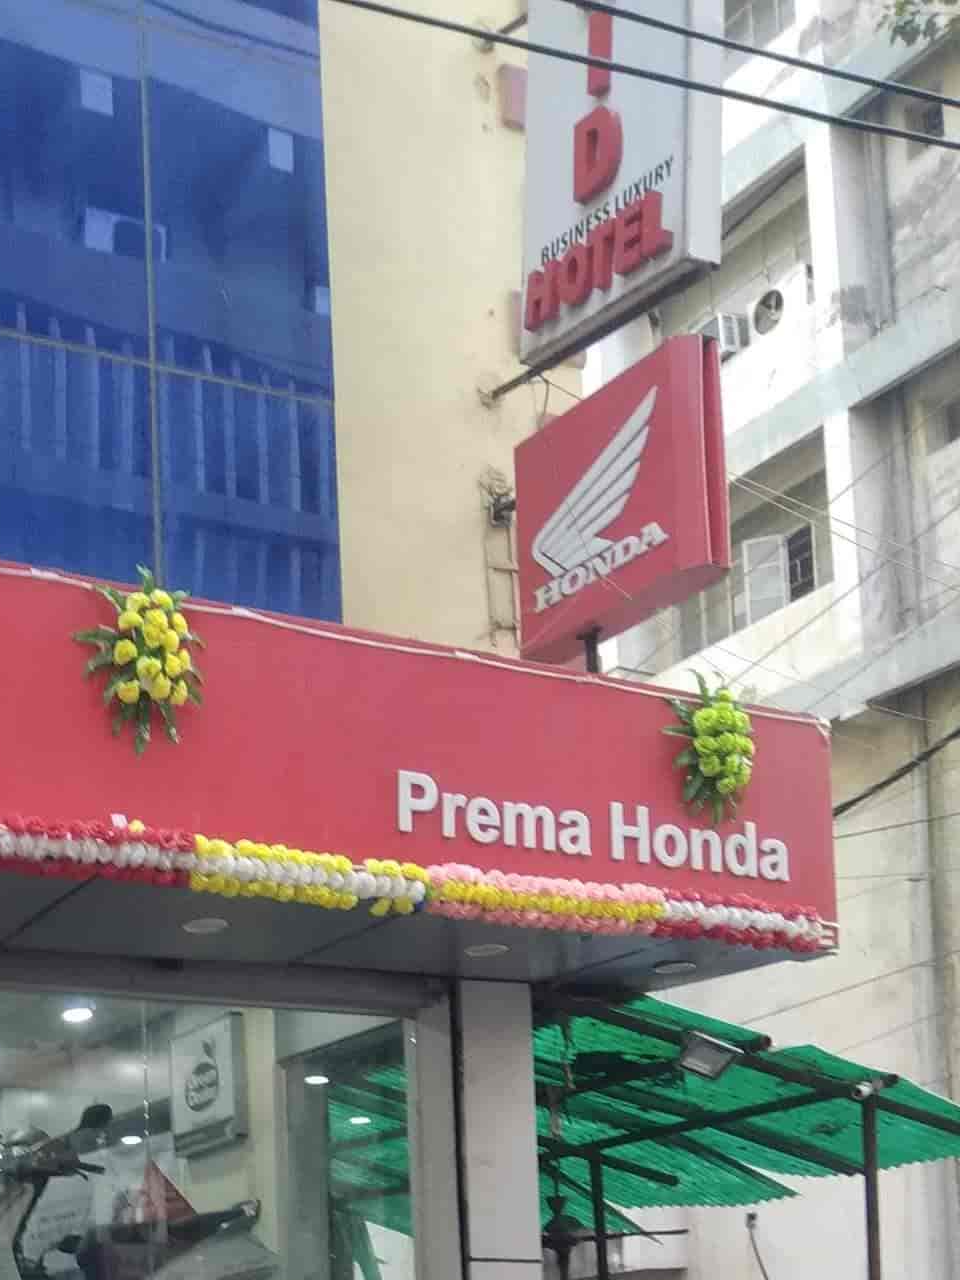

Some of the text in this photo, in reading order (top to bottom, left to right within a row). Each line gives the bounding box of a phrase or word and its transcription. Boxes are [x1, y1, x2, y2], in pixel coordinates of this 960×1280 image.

[524, 190, 674, 333] HOTEL
[540, 155, 675, 266] BUSINESS LUXURY
[533, 521, 670, 614] HONDA
[397, 769, 791, 883] Prema Honda
